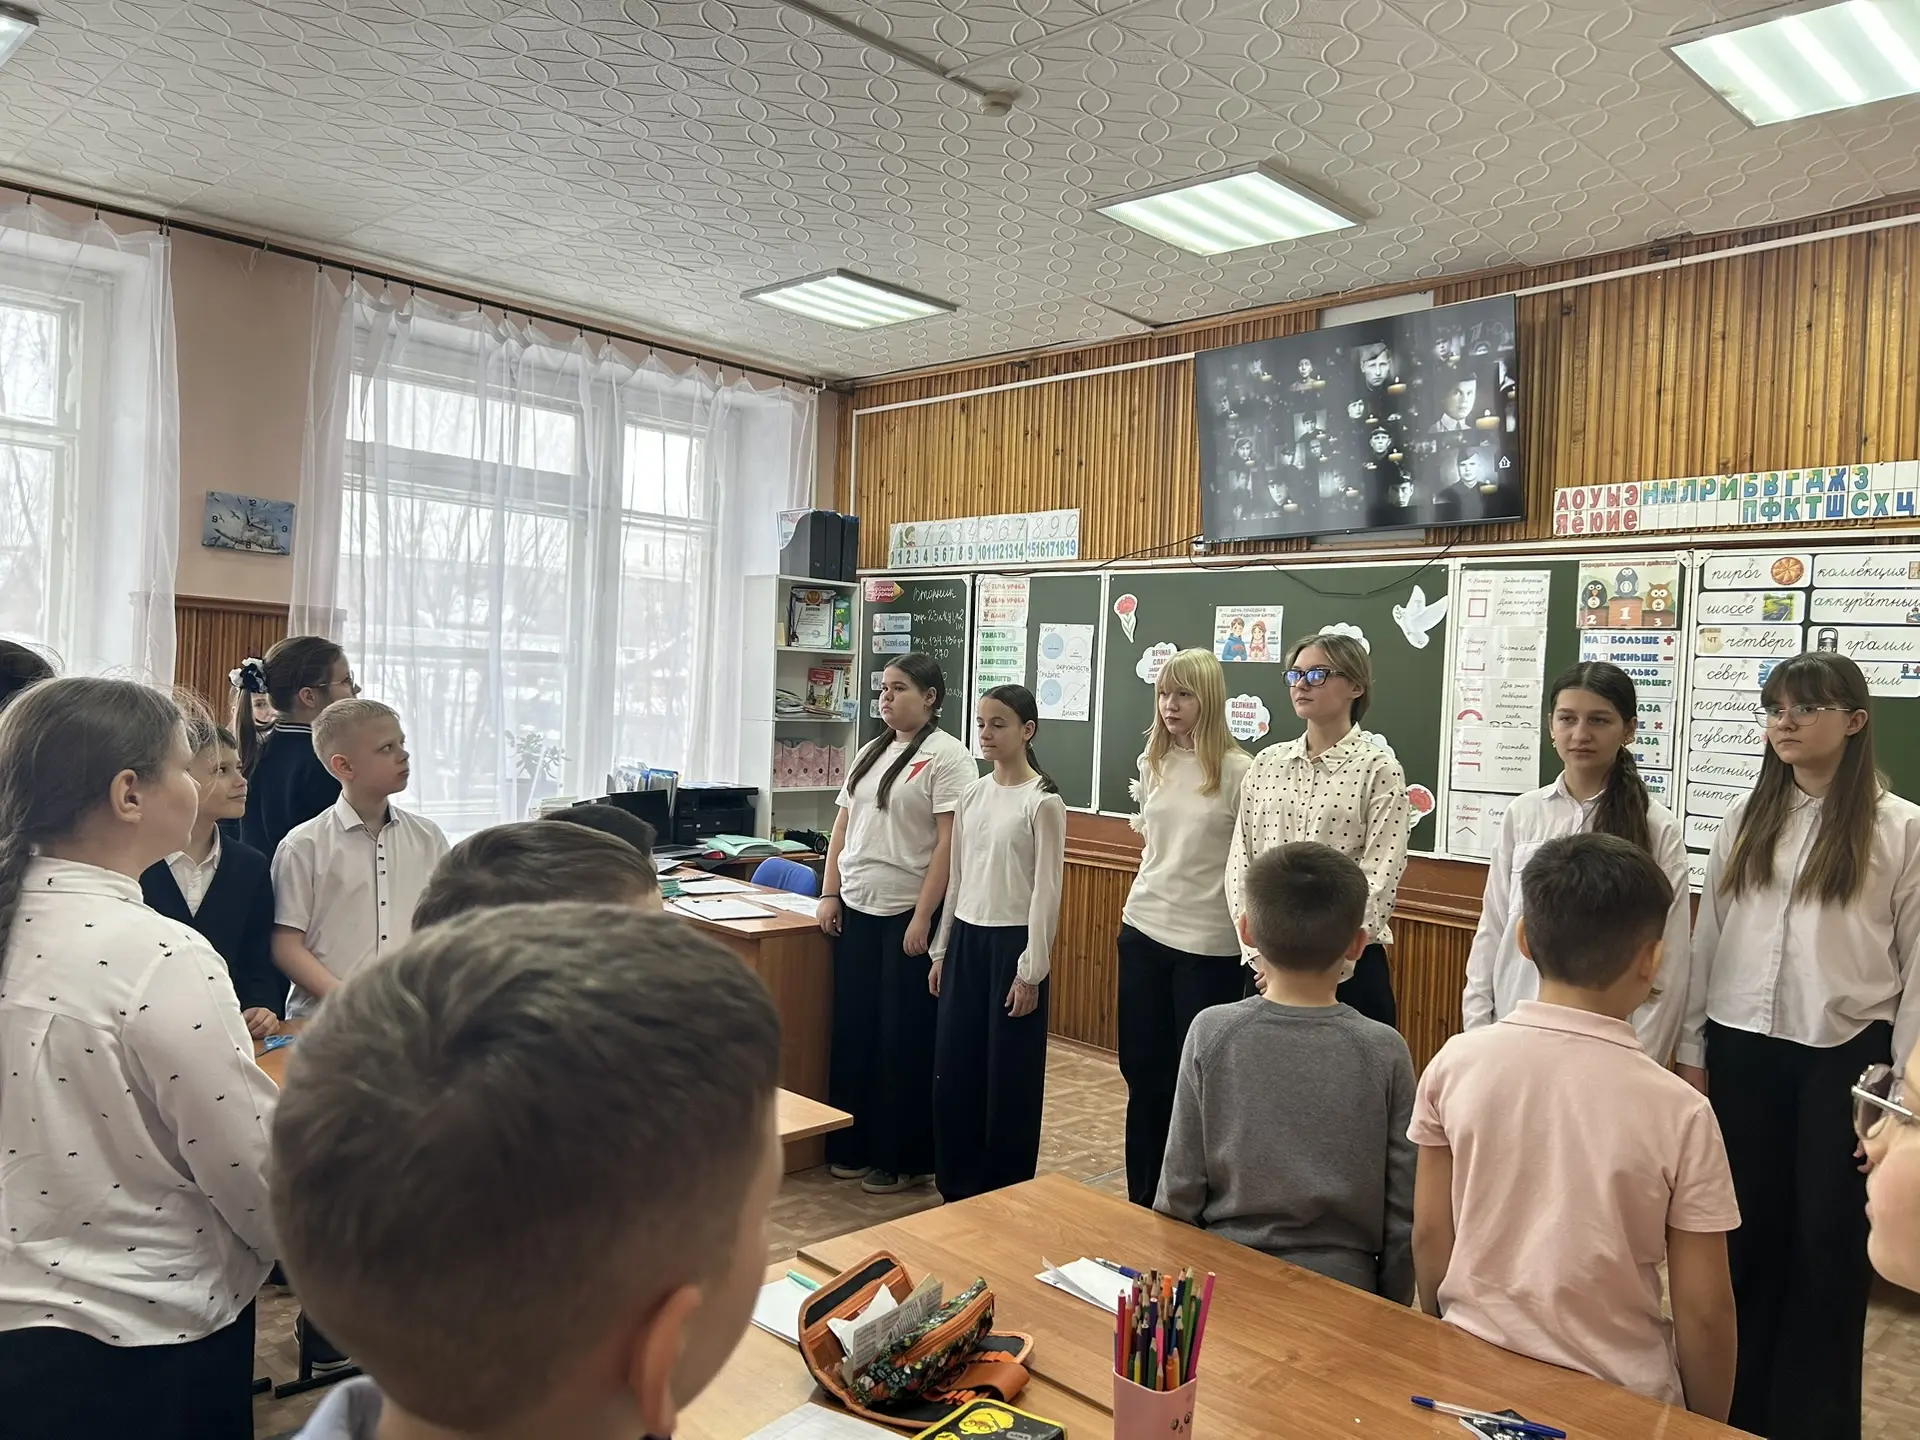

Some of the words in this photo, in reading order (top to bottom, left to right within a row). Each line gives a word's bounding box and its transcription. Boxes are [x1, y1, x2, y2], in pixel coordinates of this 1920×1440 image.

[924, 525, 932, 545] 1
[938, 524, 947, 545] 2
[951, 523, 962, 544] 3
[968, 522, 977, 543] 4
[984, 521, 994, 541] 5
[999, 519, 1010, 540] 6
[1016, 518, 1026, 539] 7
[1033, 517, 1043, 539] 8
[1050, 516, 1060, 537] 9
[1066, 514, 1078, 537] 0
[978, 546, 986, 559] 10
[988, 545, 995, 559] 11
[996, 544, 1004, 559] 12
[1005, 544, 1013, 559] 13
[1015, 543, 1023, 558] 14
[1028, 542, 1036, 557] 15
[1037, 542, 1045, 556] 16
[1046, 541, 1054, 556] 17
[1056, 540, 1064, 556] 18
[1066, 540, 1075, 555] 19
[1620, 607, 1631, 619] 1
[1587, 615, 1596, 625] 2
[1654, 618, 1661, 626] 3
[1584, 636, 1598, 644] НА
[1611, 636, 1659, 644] БОЛЬШЕ
[1707, 636, 1718, 644] ЧТ
[1845, 640, 1914, 657] грамм
[1610, 654, 1659, 662] МЕНЬШЕ
[1638, 704, 1661, 712] АЗА
[1636, 737, 1659, 745] АЗА
